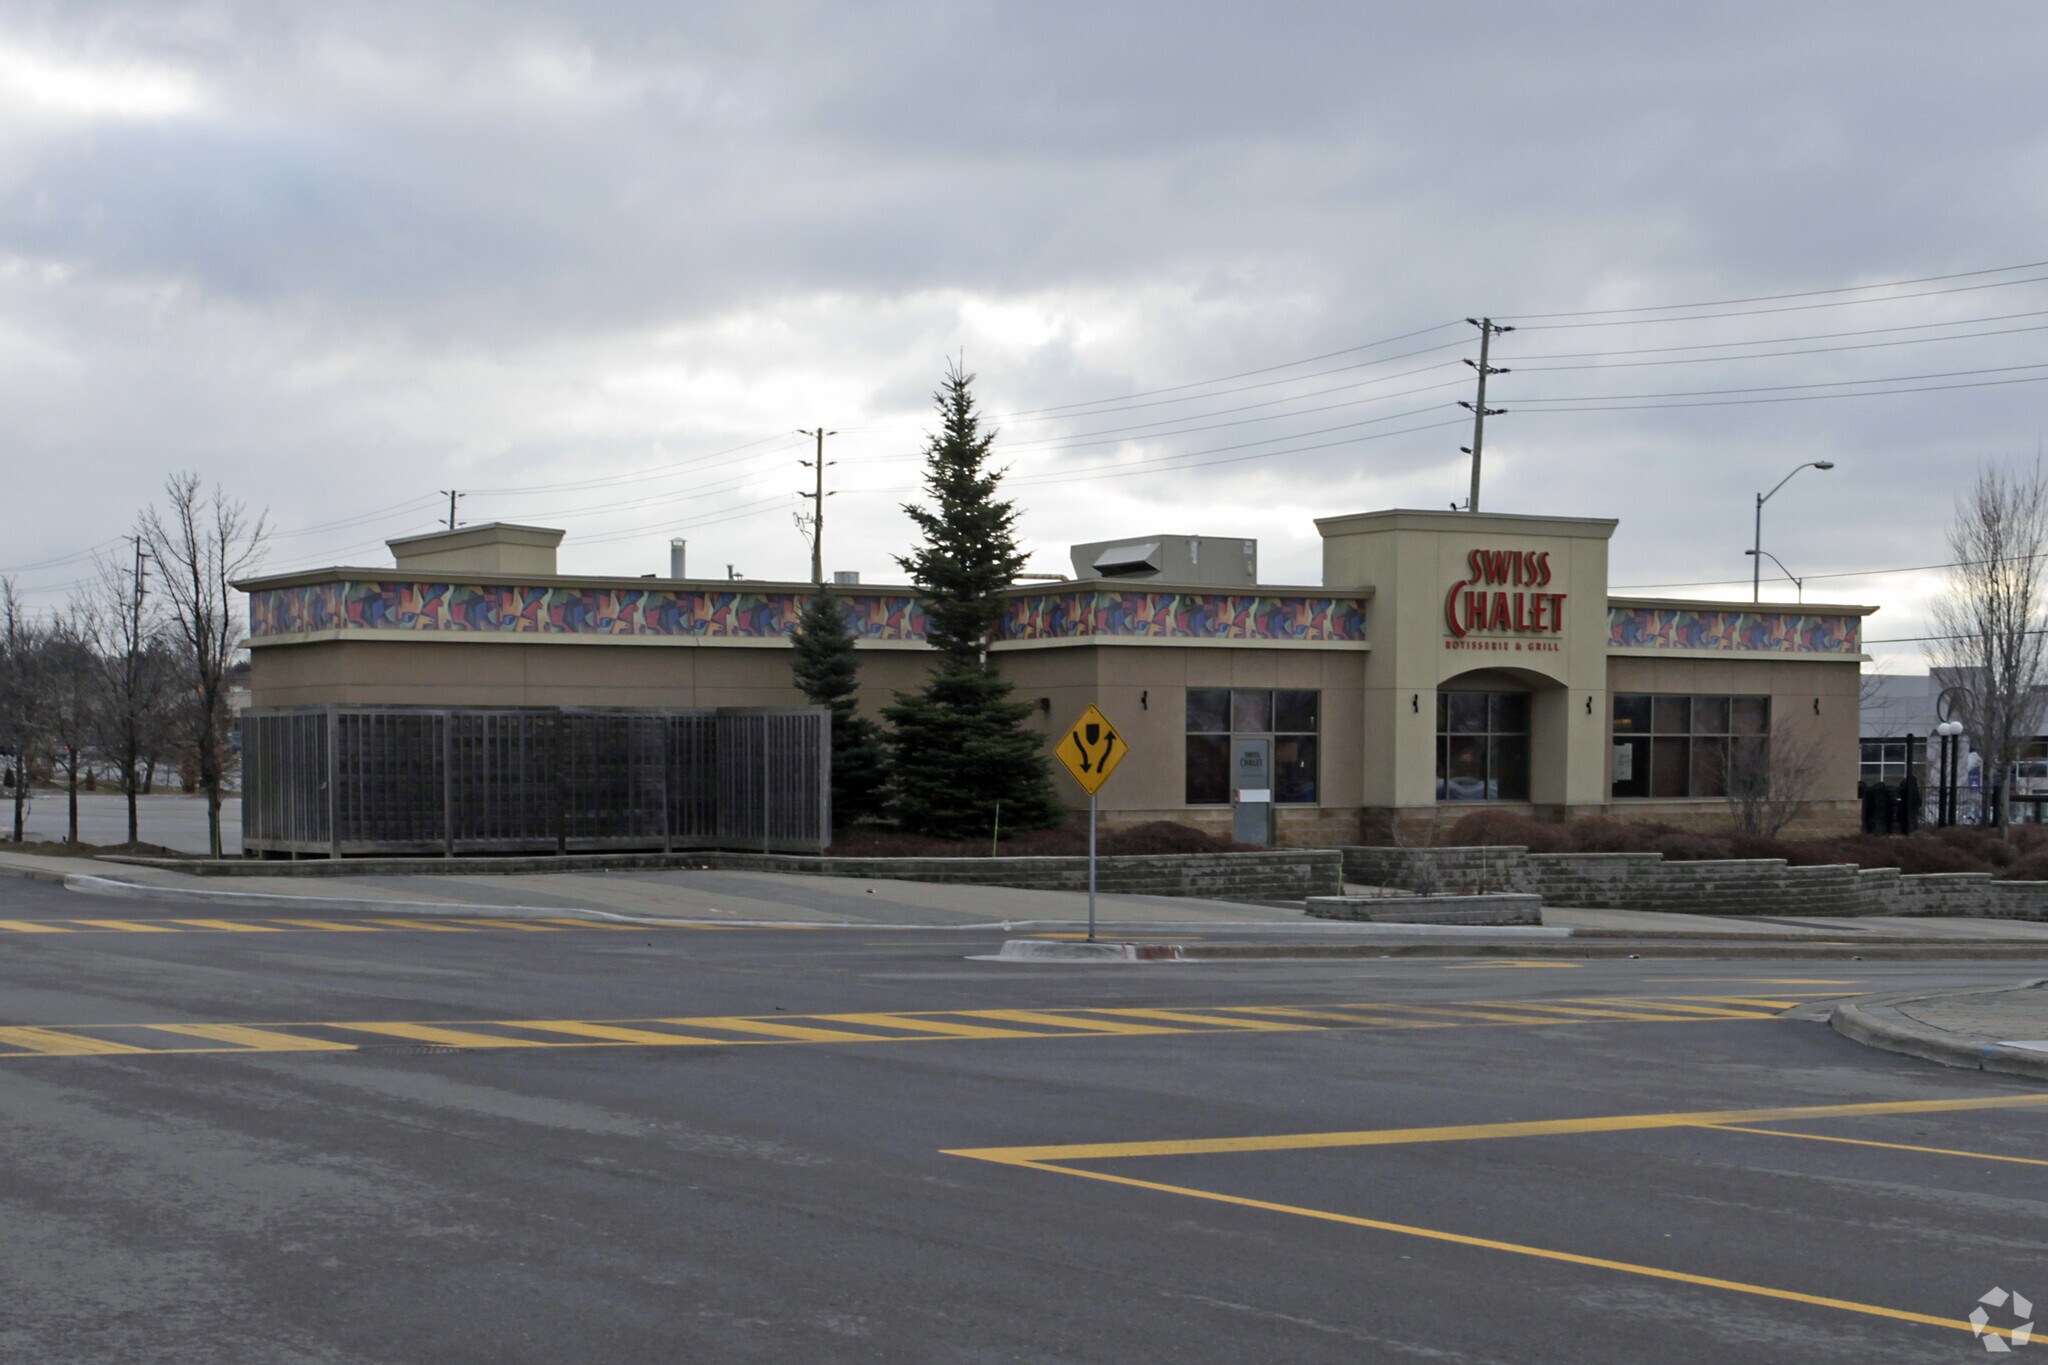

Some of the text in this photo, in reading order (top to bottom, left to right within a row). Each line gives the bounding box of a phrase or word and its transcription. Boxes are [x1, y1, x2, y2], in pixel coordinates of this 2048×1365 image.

[1467, 549, 1551, 586] SWISS
[1444, 579, 1567, 638] CHALET
[1445, 641, 1559, 652] ROTISSERIE & GRILL
